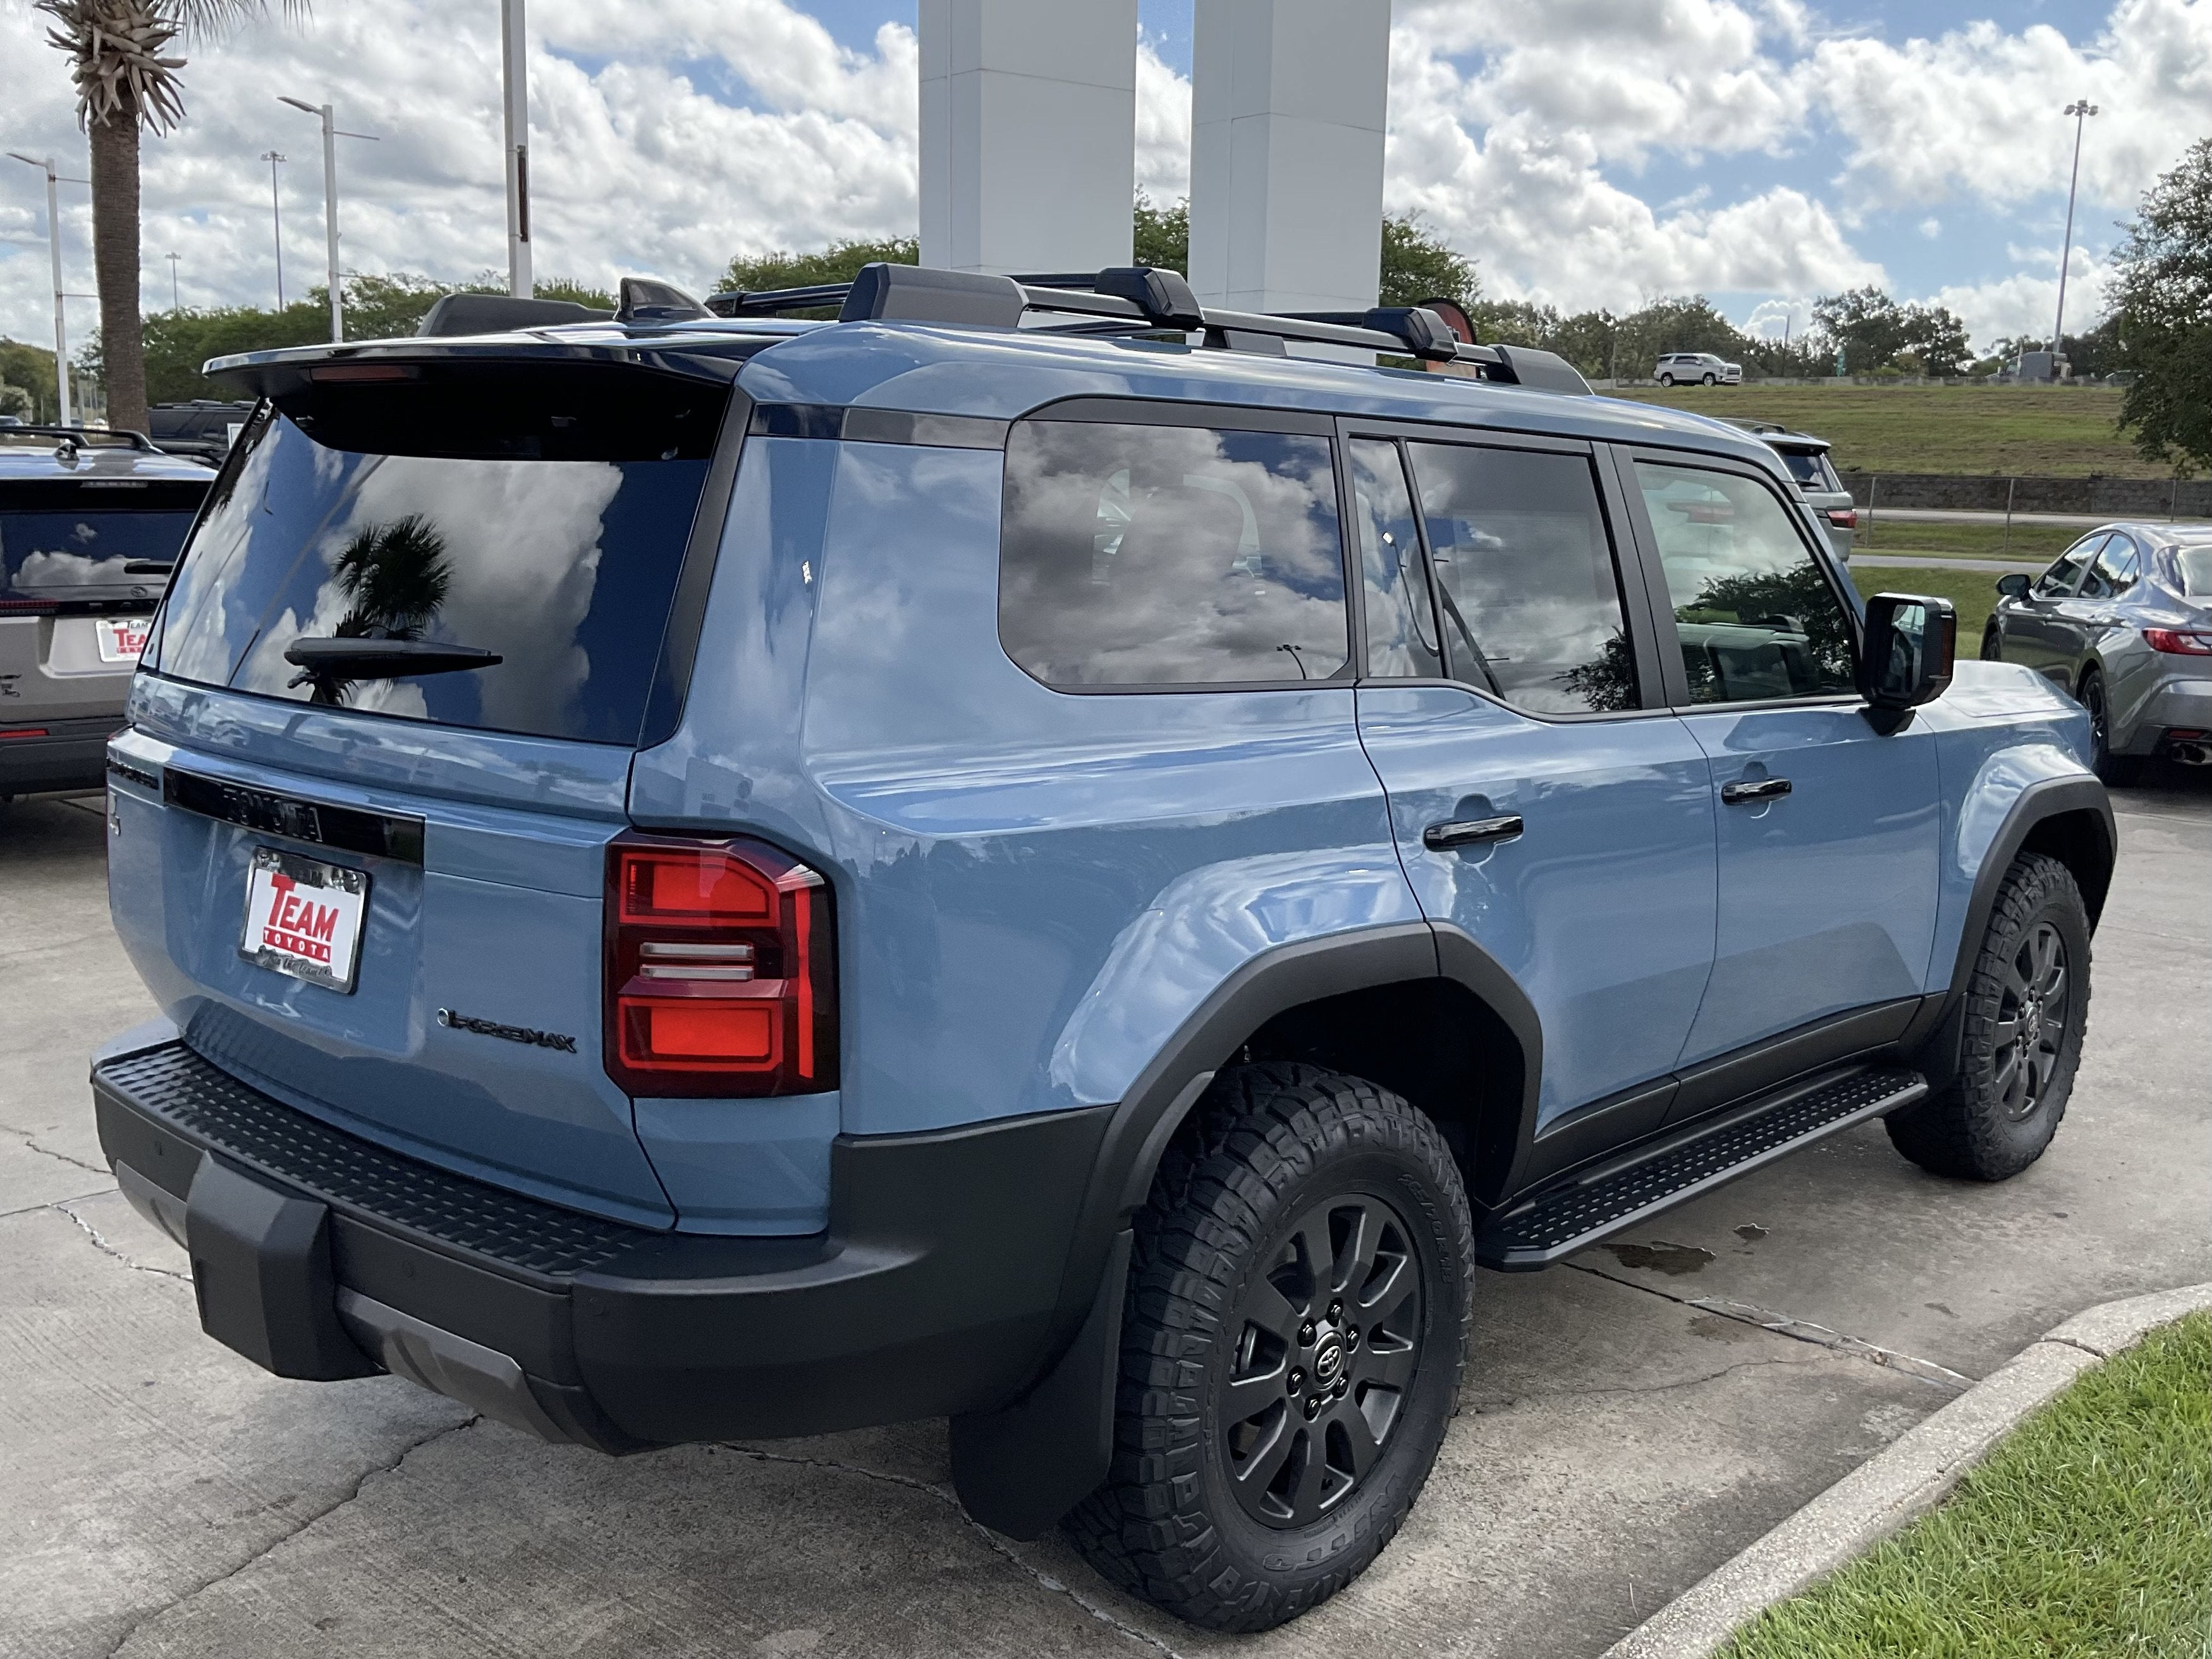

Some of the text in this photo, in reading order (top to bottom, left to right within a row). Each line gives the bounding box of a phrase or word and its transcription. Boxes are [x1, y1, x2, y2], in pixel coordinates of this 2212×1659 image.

[113, 629, 146, 647] TEA
[268, 872, 339, 942] TEAM
[264, 929, 329, 960] TOYOTA
